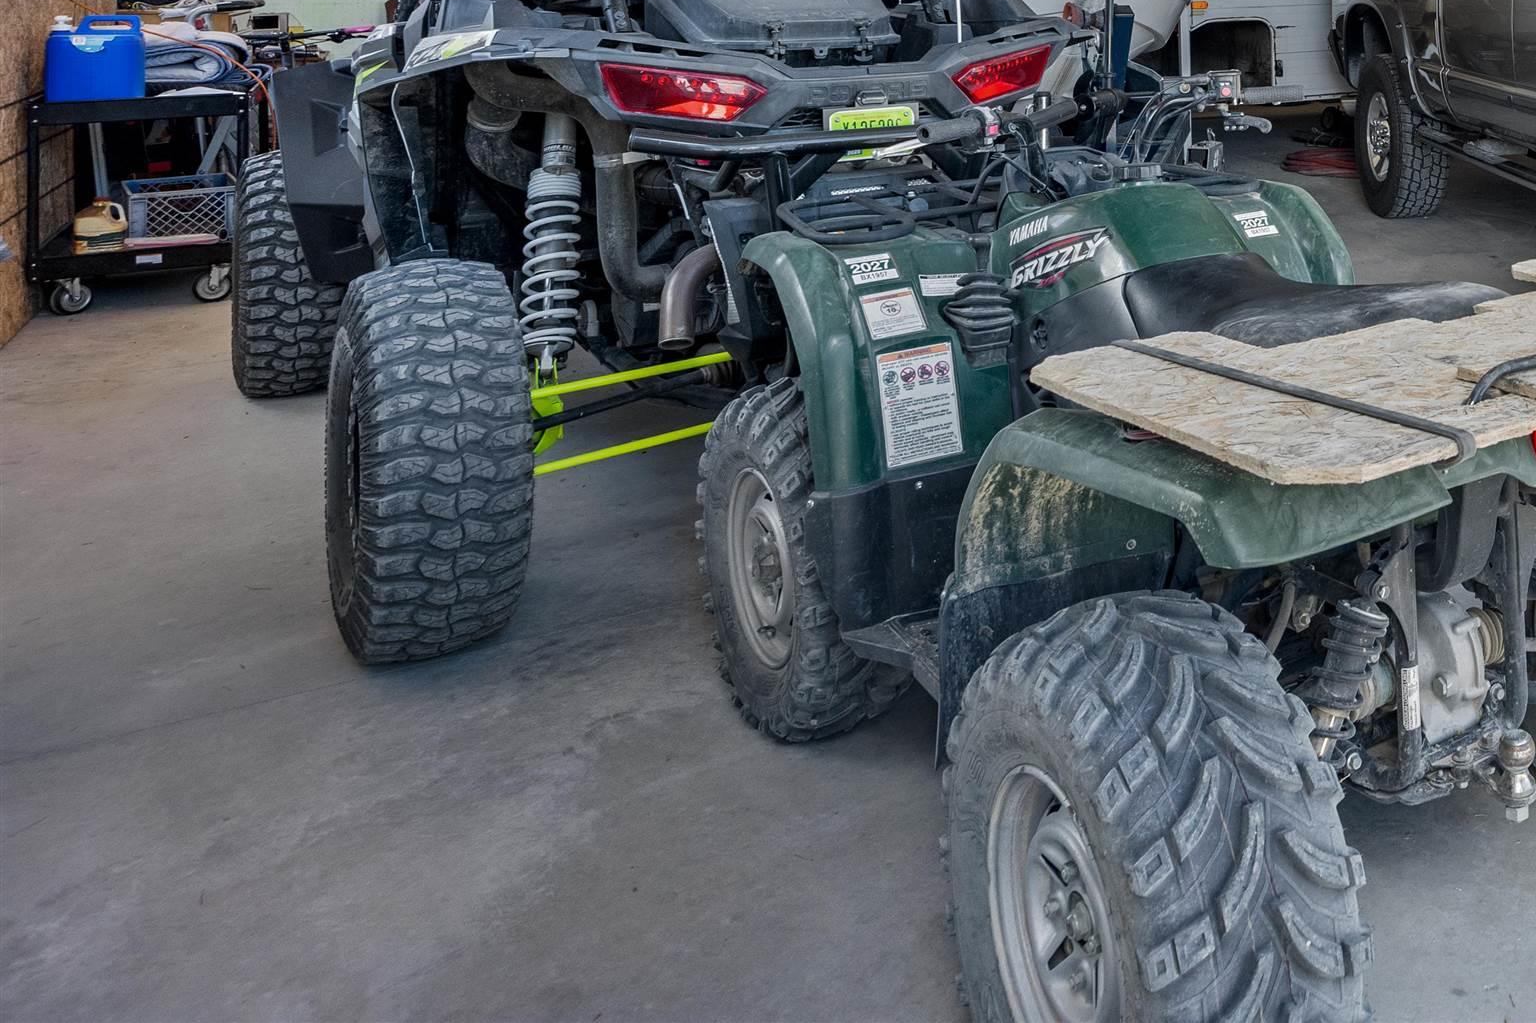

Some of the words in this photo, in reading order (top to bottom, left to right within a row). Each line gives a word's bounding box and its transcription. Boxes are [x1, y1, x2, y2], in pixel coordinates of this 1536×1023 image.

[1009, 215, 1049, 246] YAMAHA
[1241, 217, 1269, 229] 2027
[849, 259, 890, 274] 2027
[1010, 228, 1109, 289] GRIZZLY
